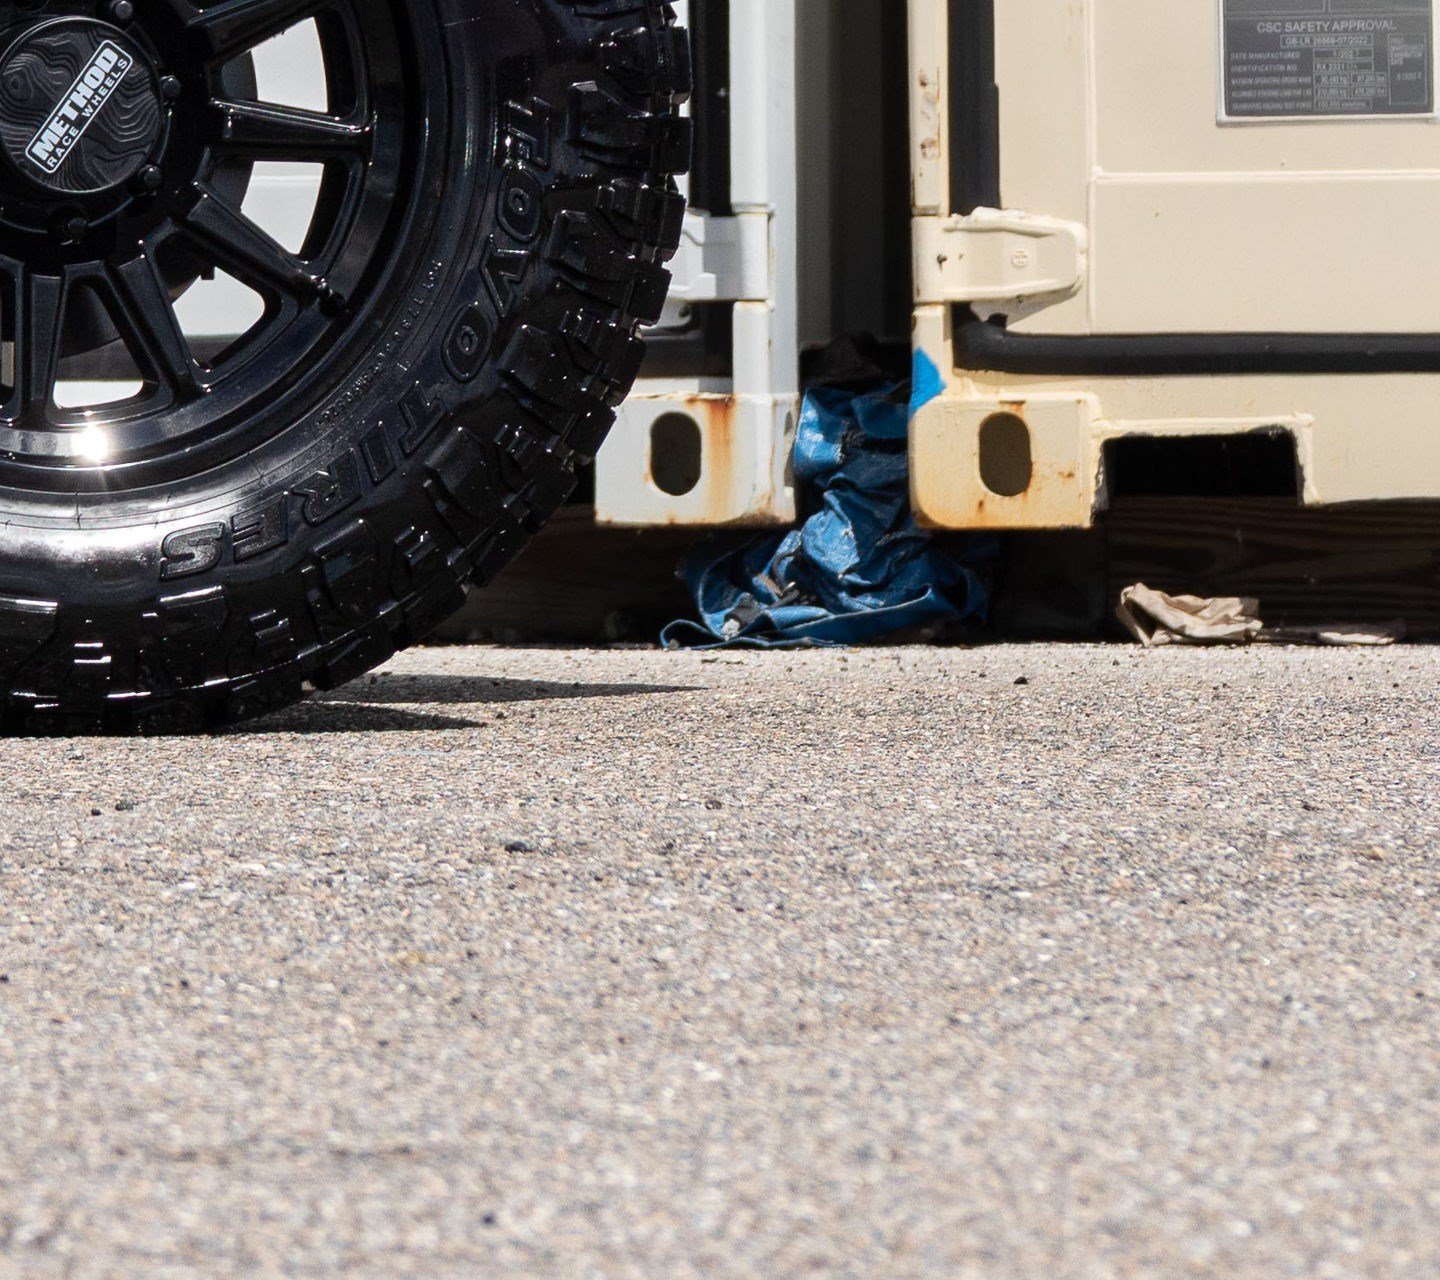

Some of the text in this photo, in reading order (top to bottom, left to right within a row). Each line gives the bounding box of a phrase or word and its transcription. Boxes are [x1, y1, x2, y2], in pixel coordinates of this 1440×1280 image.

[1257, 20, 1397, 33] CSC SAFETY APPROVAL
[30, 47, 119, 160] METHOD
[46, 58, 128, 168] RACE WHEELS
[443, 96, 551, 382] TOYO
[161, 382, 447, 579] TIRES
